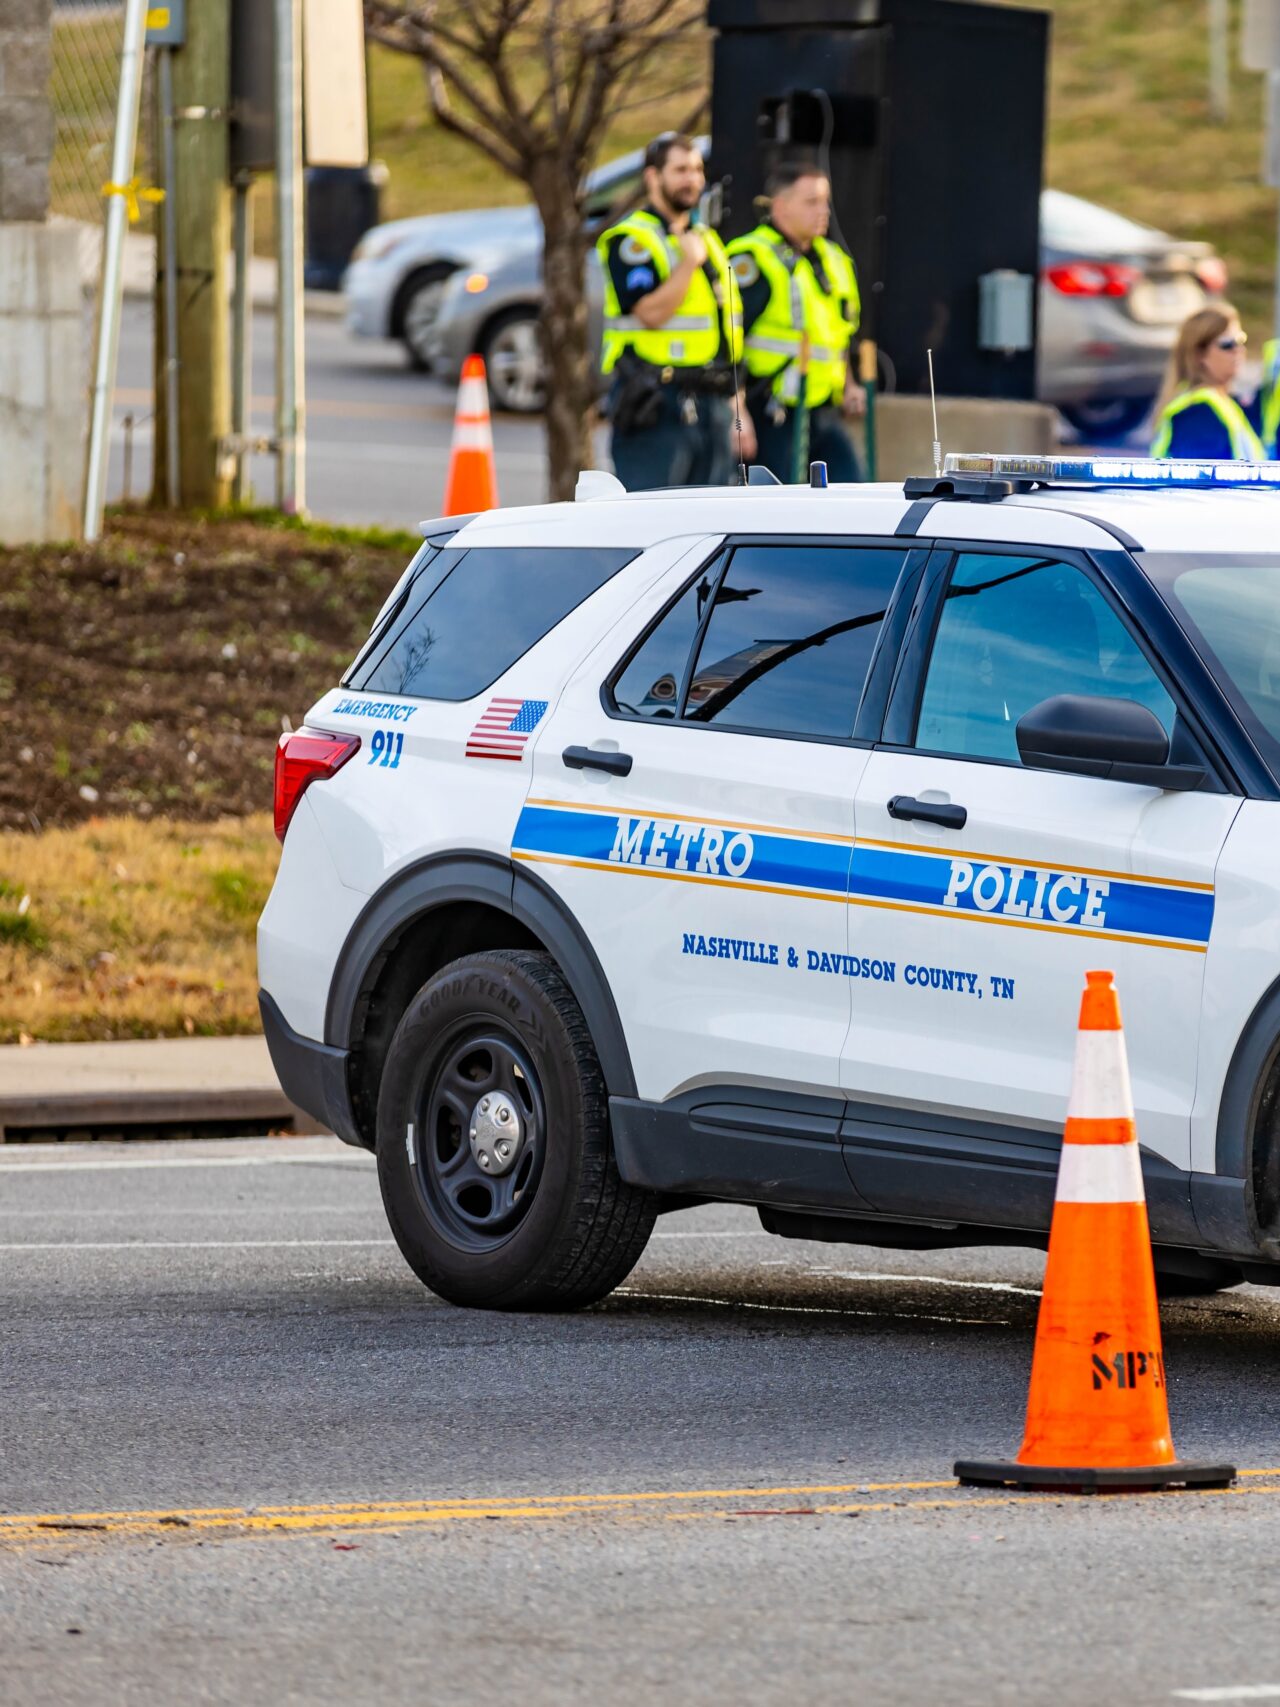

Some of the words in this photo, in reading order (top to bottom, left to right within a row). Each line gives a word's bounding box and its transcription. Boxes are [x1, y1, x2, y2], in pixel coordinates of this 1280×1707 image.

[332, 698, 418, 722] EMERGENCY
[367, 729, 404, 769] 911
[608, 816, 754, 878] METRO
[943, 860, 1110, 928] POLICE
[682, 933, 779, 965] NASHVILLE
[787, 946, 799, 968] &
[807, 950, 896, 982] DAVIDSON
[904, 964, 983, 999] COUNTY,
[990, 976, 1015, 1000] TN
